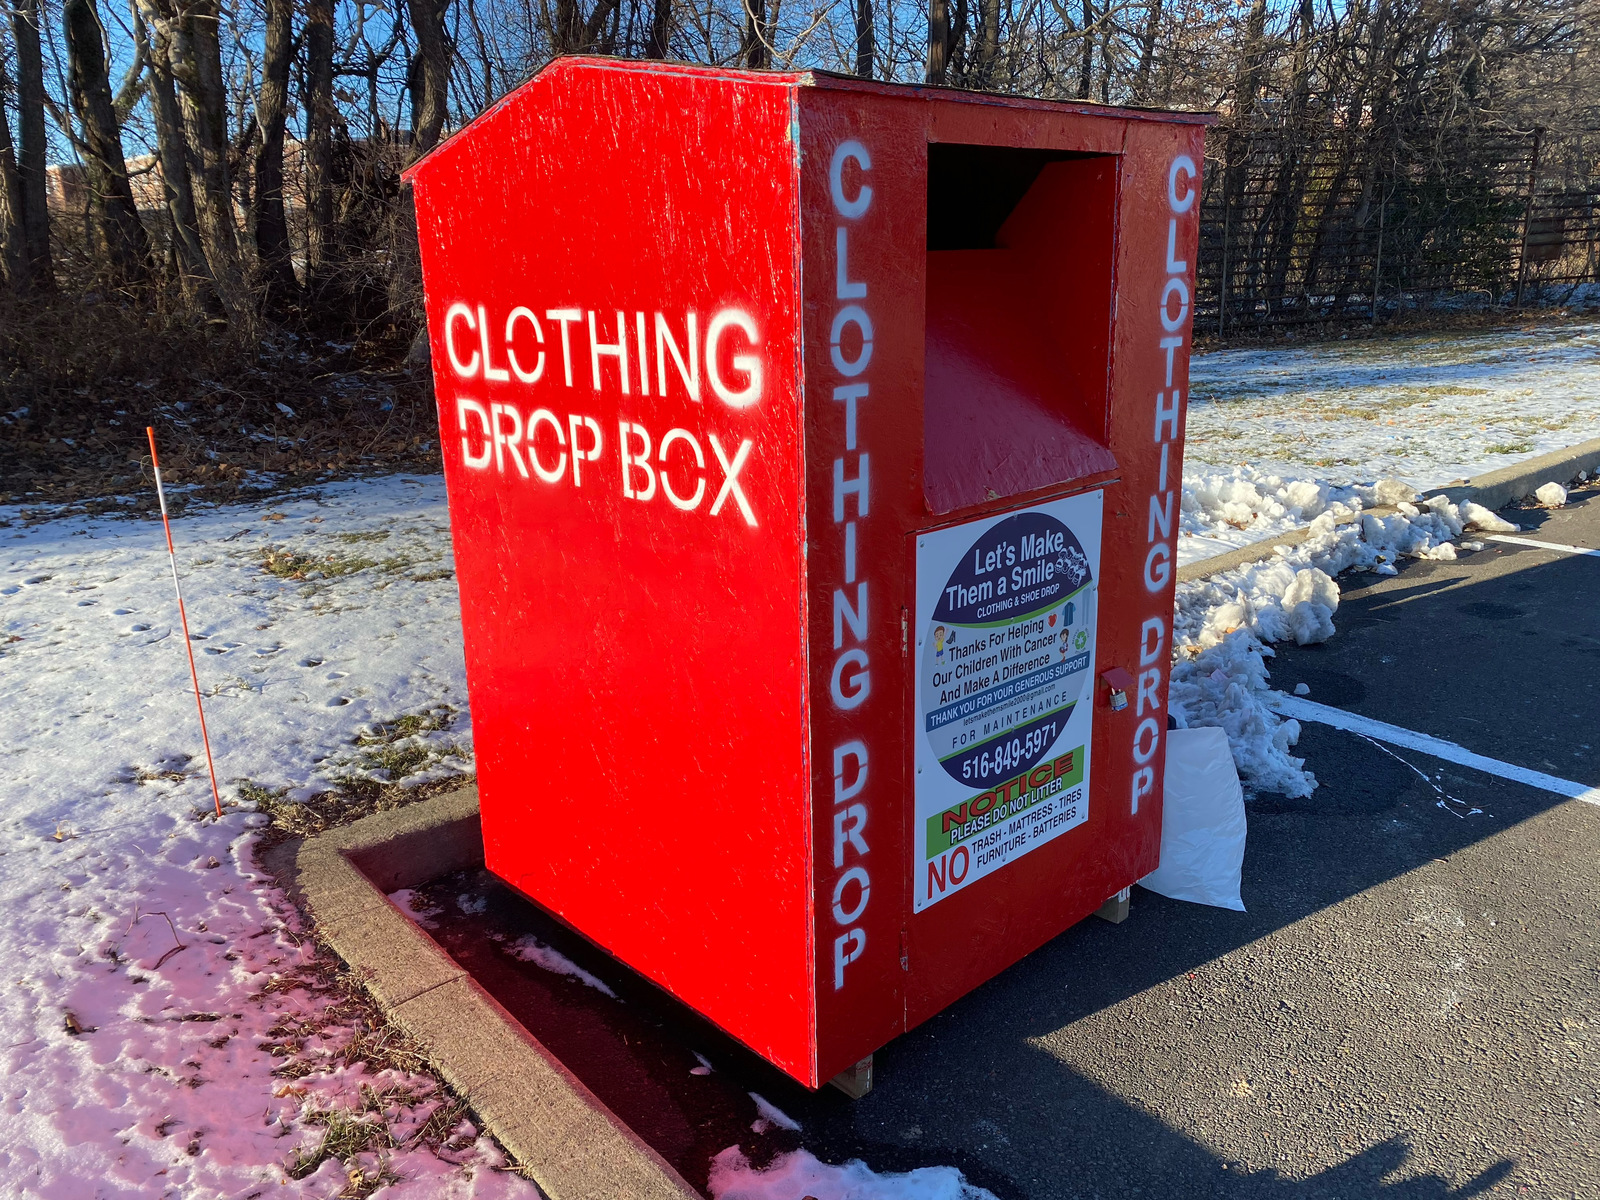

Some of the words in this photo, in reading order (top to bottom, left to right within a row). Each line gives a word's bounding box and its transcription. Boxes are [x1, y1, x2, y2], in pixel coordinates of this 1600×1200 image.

[445, 302, 763, 409] CLOTHING
[1143, 155, 1196, 592] CLOTHING
[829, 139, 873, 711] CLOTHING
[457, 397, 601, 488] DROP
[619, 420, 759, 527] BOX
[974, 541, 1016, 576] Let's
[1020, 529, 1065, 562] Make
[945, 580, 993, 611] Them
[997, 576, 1007, 596] a
[1010, 559, 1055, 591] Smile
[976, 597, 1014, 619] CLOTHING
[1013, 596, 1019, 606] &
[1020, 589, 1041, 605] SHOE
[1040, 583, 1060, 598] DROP
[932, 670, 953, 688] Our
[955, 653, 998, 680] Children
[1000, 643, 1023, 663] With
[1024, 632, 1058, 654] Cancer
[948, 638, 987, 662] Thanks
[988, 632, 1006, 649] For
[1007, 618, 1045, 641] Helping
[930, 705, 959, 727] THANK
[958, 699, 975, 717] YOU
[976, 692, 993, 708] FOR
[991, 685, 1014, 701] YOUR
[1014, 669, 1054, 693] GENEROUS
[1055, 656, 1087, 676] SUPPORT
[939, 685, 961, 705] And
[963, 672, 990, 696] Make
[992, 670, 1000, 684] A
[1002, 653, 1050, 680] Difference
[963, 683, 1056, 727] letsmakethemsmile2000@gmail.com
[952, 729, 976, 749] FOR
[983, 691, 1067, 736] MAINTENANCE
[1131, 616, 1165, 815] DROP
[962, 721, 1057, 779] 516-849-5971
[942, 752, 1074, 834] NOTICE
[950, 811, 992, 845] PLEASE
[992, 804, 1007, 824] DO
[1009, 792, 1030, 815] NOT
[1030, 776, 1063, 803] LITTER
[971, 830, 1001, 854] TRASH
[1008, 803, 1053, 835] MATTRESS
[1058, 788, 1082, 809] TIRES
[832, 740, 871, 991] DROP
[976, 832, 1026, 868] FURNITURE
[1032, 806, 1077, 838] BATTERIES
[927, 845, 970, 900] NO
